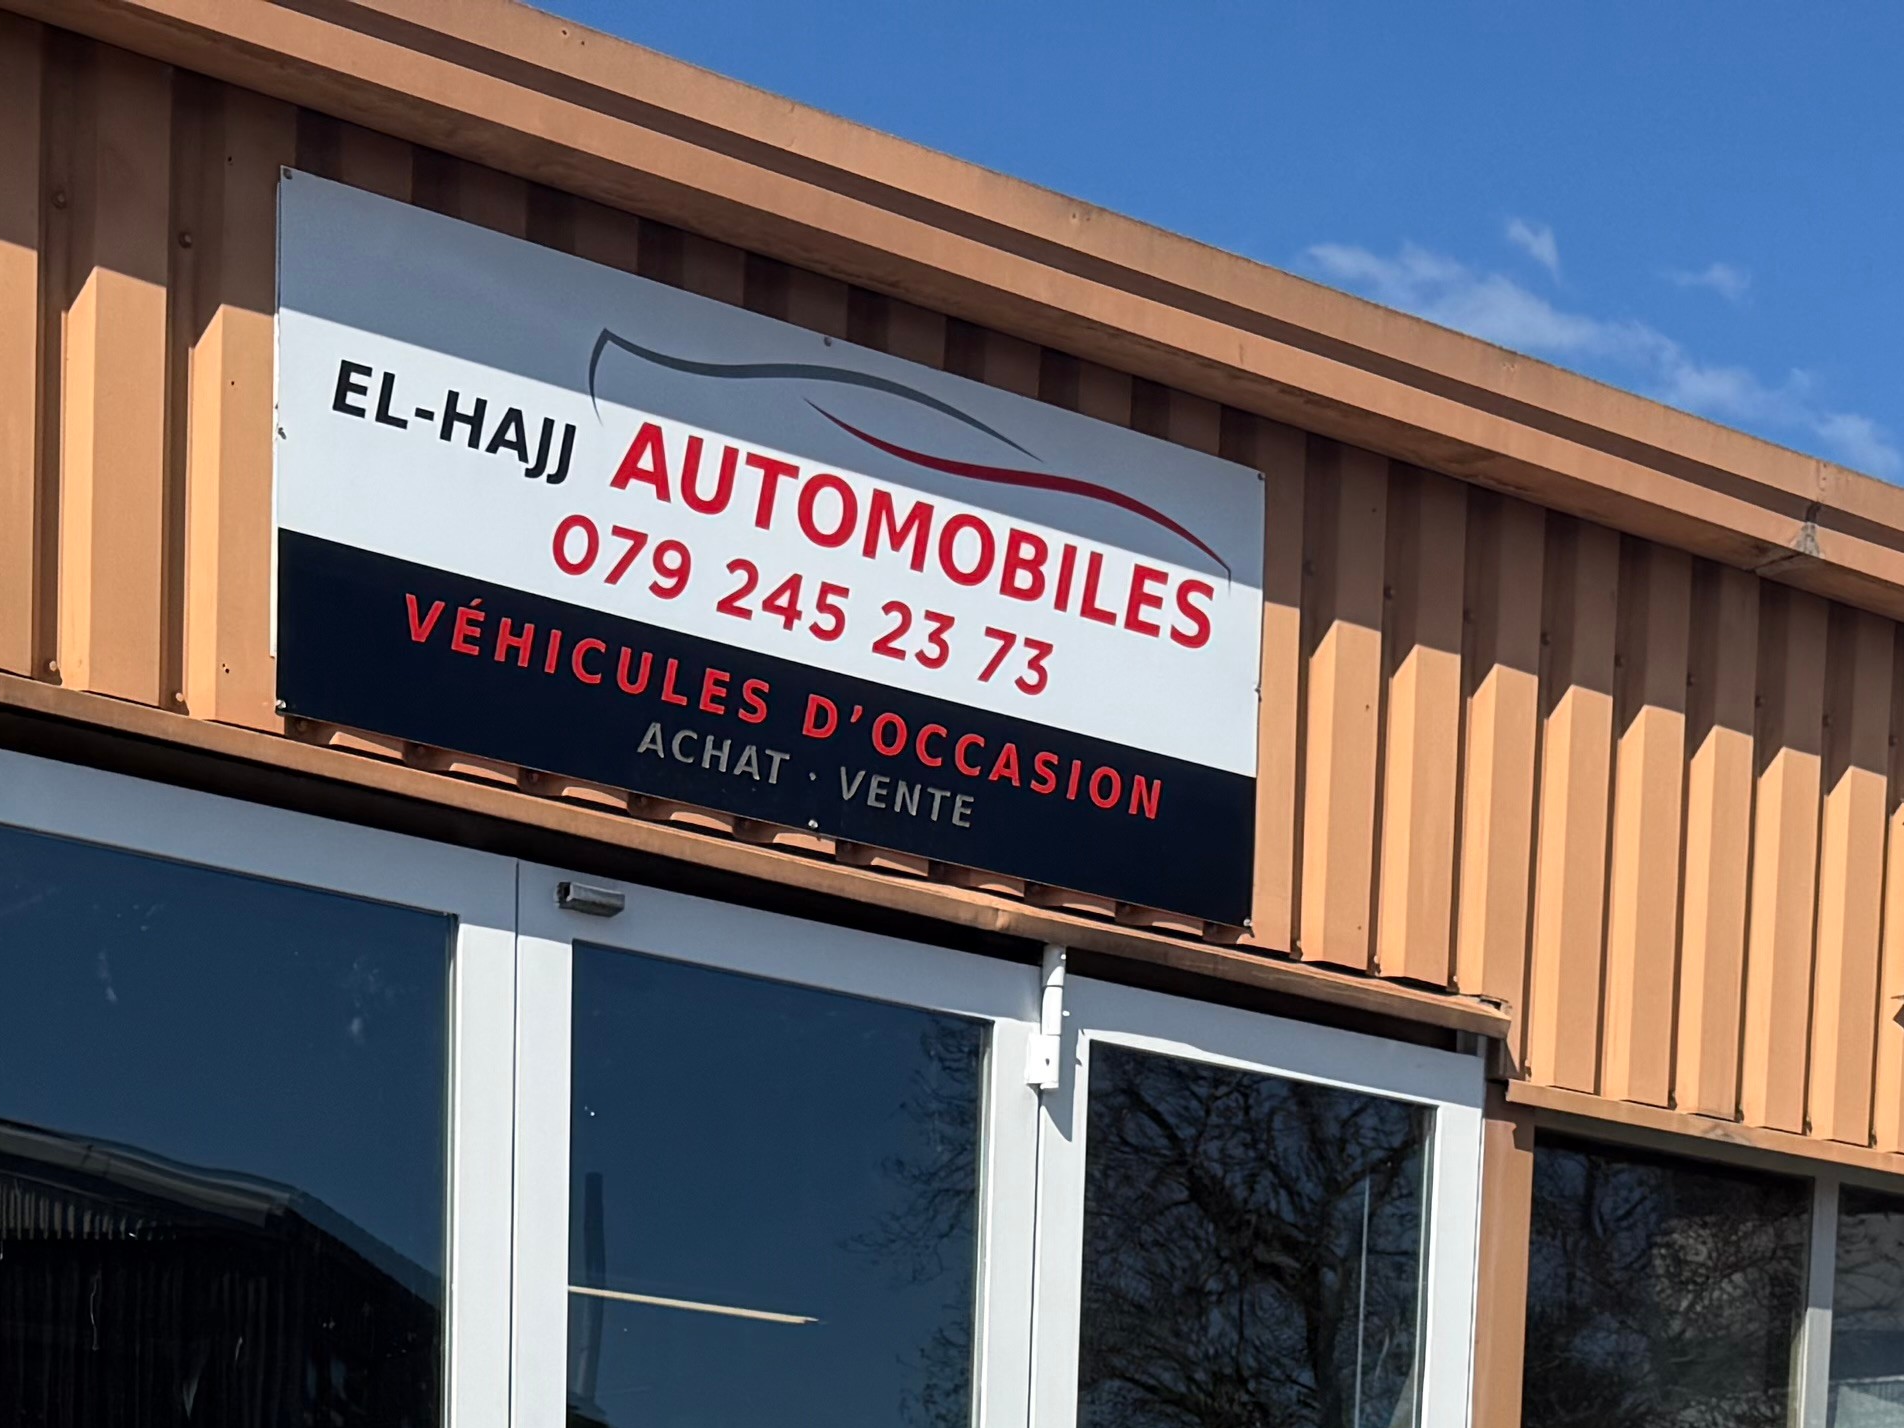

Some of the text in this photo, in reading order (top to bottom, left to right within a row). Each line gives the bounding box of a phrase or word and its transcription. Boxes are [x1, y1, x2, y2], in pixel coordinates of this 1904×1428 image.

[331, 357, 1217, 649] EL-HAJJ AUTOMOBILES
[550, 513, 1055, 696] 079 245 23 73
[404, 593, 1163, 820] VÉHICULES D'OCCASION
[636, 721, 976, 829] ACHAT VENTE
